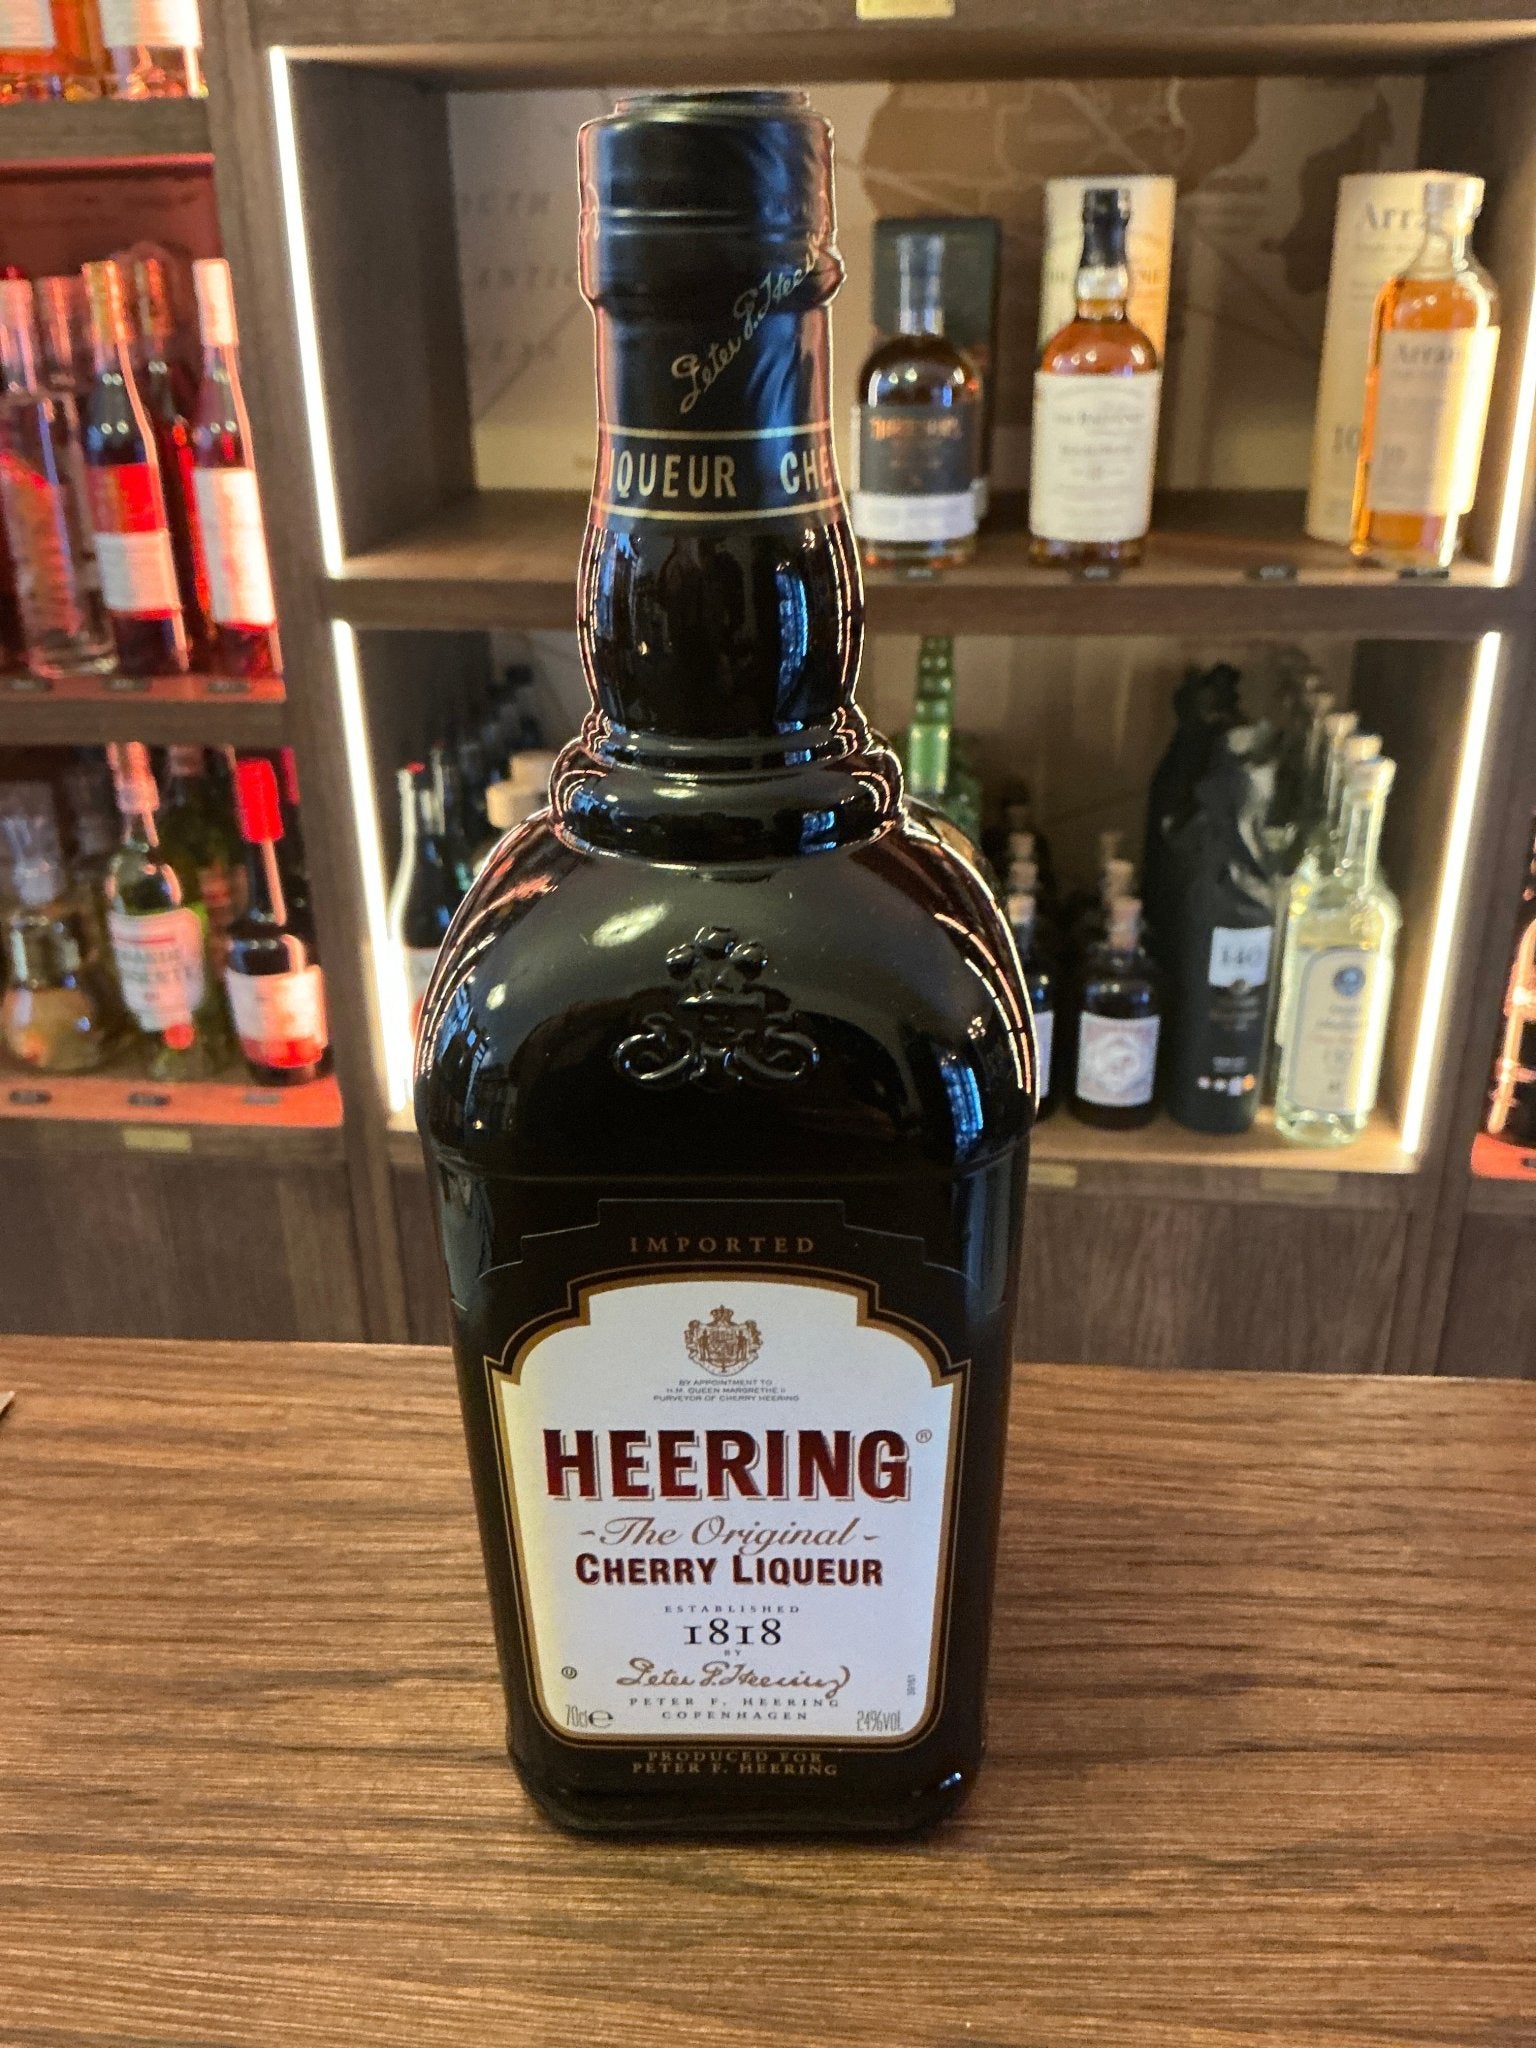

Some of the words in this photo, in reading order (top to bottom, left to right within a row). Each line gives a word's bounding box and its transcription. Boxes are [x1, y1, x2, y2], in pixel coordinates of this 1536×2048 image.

[608, 448, 737, 499] IQUEUR
[779, 445, 832, 495] CHE
[630, 1236, 816, 1255] IMPORTED
[542, 1428, 910, 1503] HEERING
[599, 1515, 680, 1547] The
[690, 1514, 859, 1557] Original
[574, 1552, 718, 1587] CHERRY
[731, 1553, 884, 1587] LIQUEUR
[664, 1605, 801, 1614] ESTABLISHED
[683, 1617, 783, 1647] 1818
[723, 1649, 742, 1657] BY
[629, 1697, 695, 1707] PETER
[742, 1698, 840, 1708] HEERING
[661, 1711, 809, 1720] COPENHAGEN
[649, 1751, 769, 1763] PRODUCED
[779, 1752, 822, 1763] FOR
[632, 1762, 702, 1775] PETER
[738, 1763, 839, 1776] HEERING
